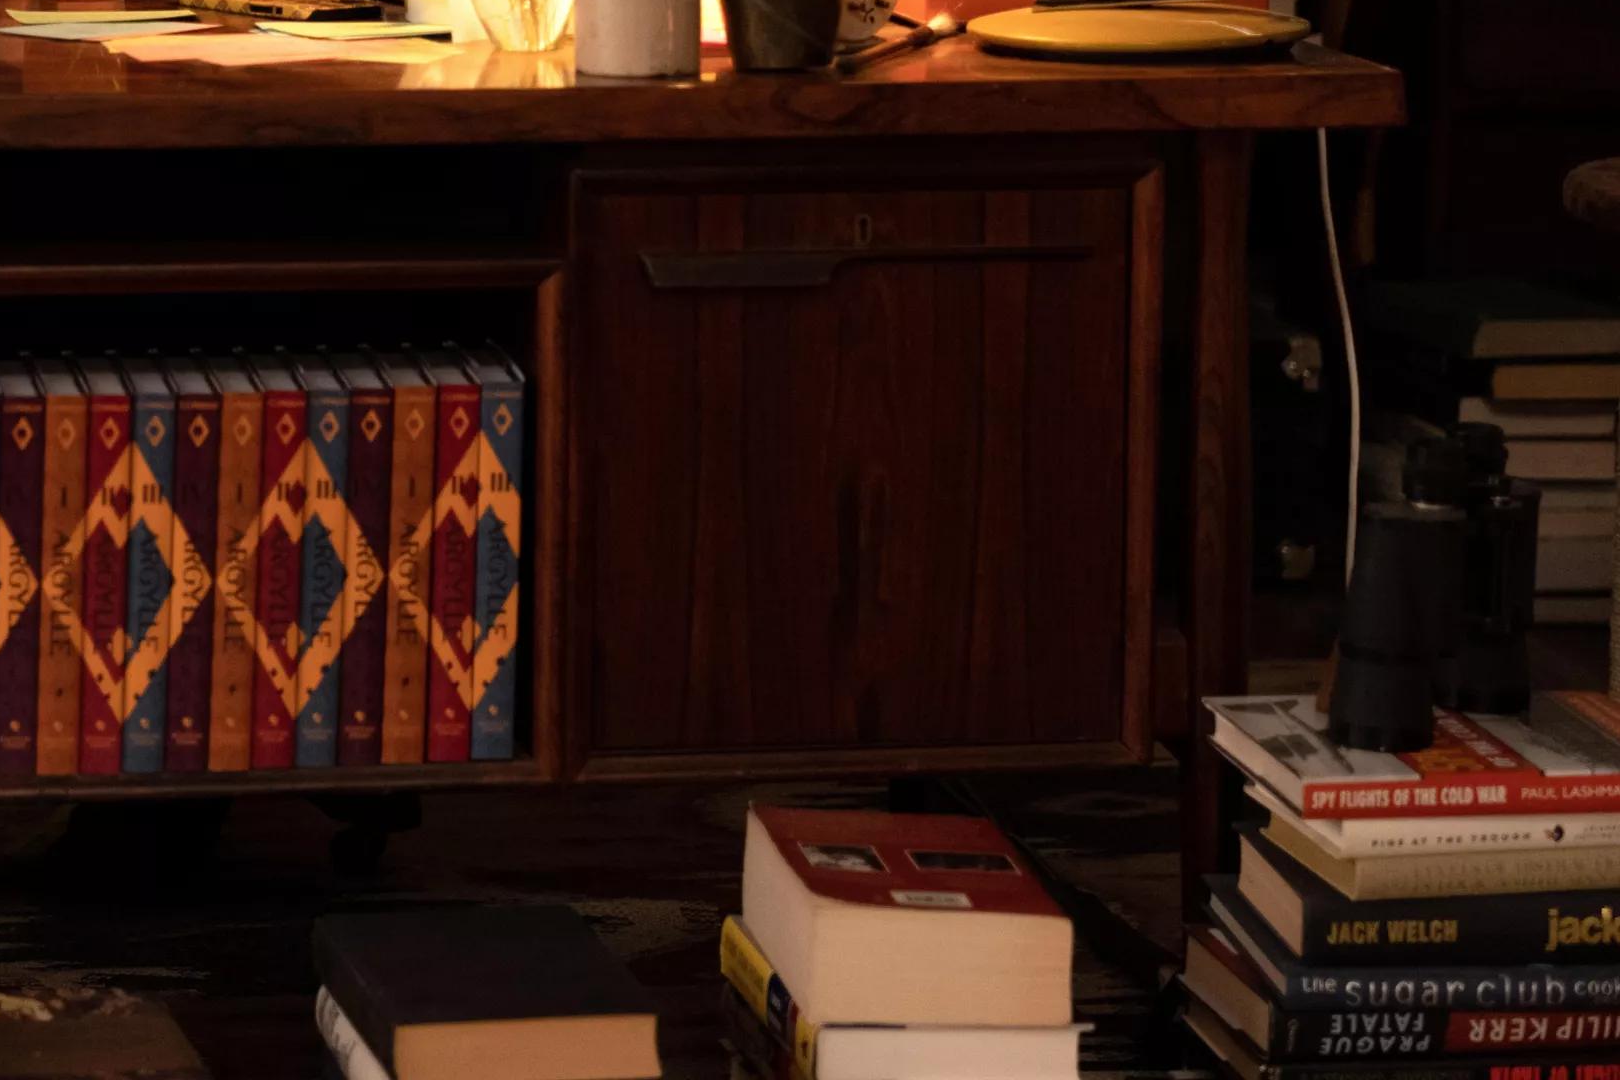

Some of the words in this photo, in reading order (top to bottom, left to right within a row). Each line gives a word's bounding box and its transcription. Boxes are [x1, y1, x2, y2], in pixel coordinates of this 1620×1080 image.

[1312, 790, 1337, 809] SPY
[1339, 788, 1390, 808] FLIGHTS
[1393, 788, 1411, 807] OF
[1414, 786, 1437, 806] THE
[1440, 785, 1474, 805] COLD
[1476, 784, 1508, 804] WAR
[1520, 786, 1557, 800] PAUL
[1328, 921, 1378, 944] JACK
[1387, 919, 1458, 942] WELCH
[1302, 976, 1337, 993] the
[1345, 980, 1465, 1006] sugar
[1476, 974, 1565, 1005] club
[1331, 1013, 1424, 1034] FATALE
[1468, 1019, 1548, 1043] KERR
[1320, 1035, 1431, 1055] PRAGUE
